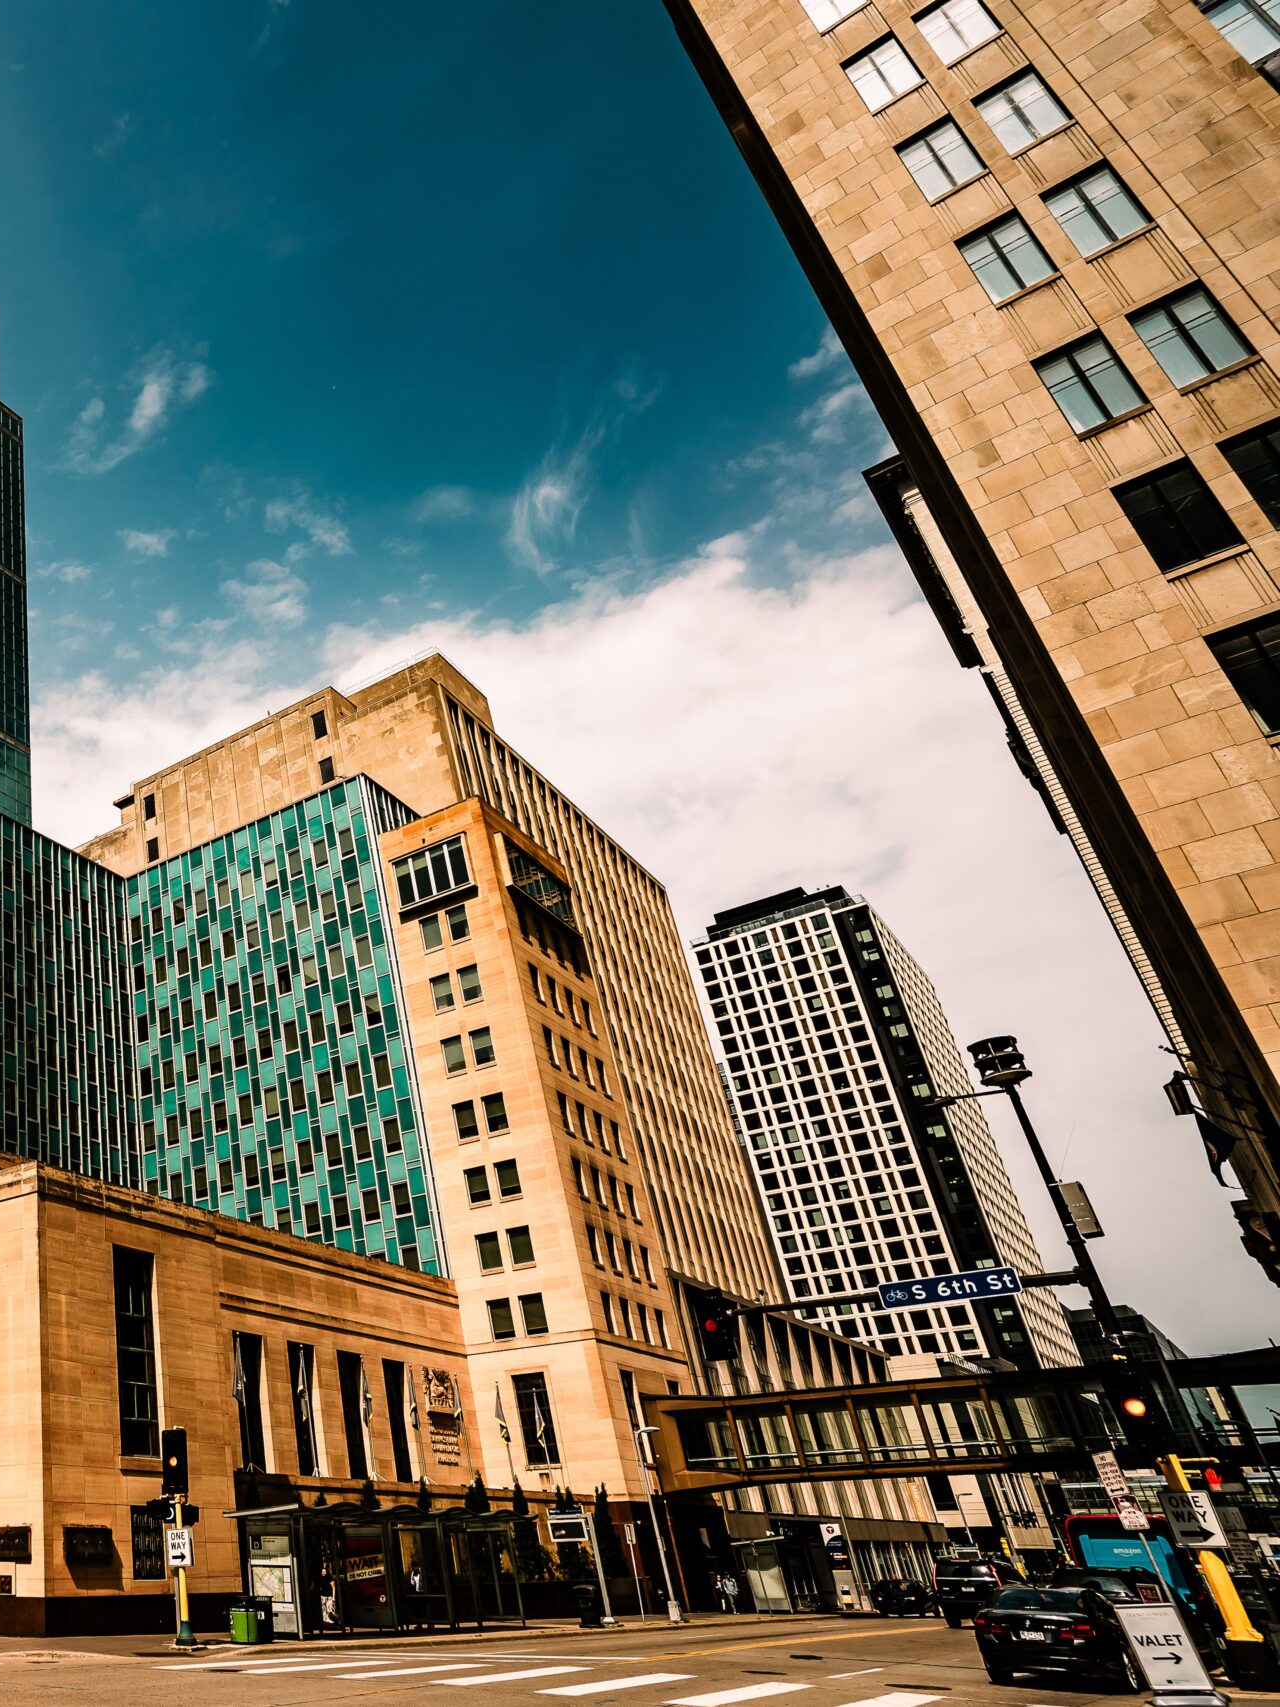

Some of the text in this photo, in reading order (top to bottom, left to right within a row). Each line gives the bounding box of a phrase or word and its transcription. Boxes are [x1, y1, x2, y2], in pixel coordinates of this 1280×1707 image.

[911, 1274, 1014, 1299] S 6th St
[1168, 1496, 1203, 1508] ONE
[1172, 1511, 1207, 1523] WAY
[170, 1531, 186, 1540] ONE
[170, 1542, 186, 1550] WAY
[1133, 1634, 1183, 1646] VALET
